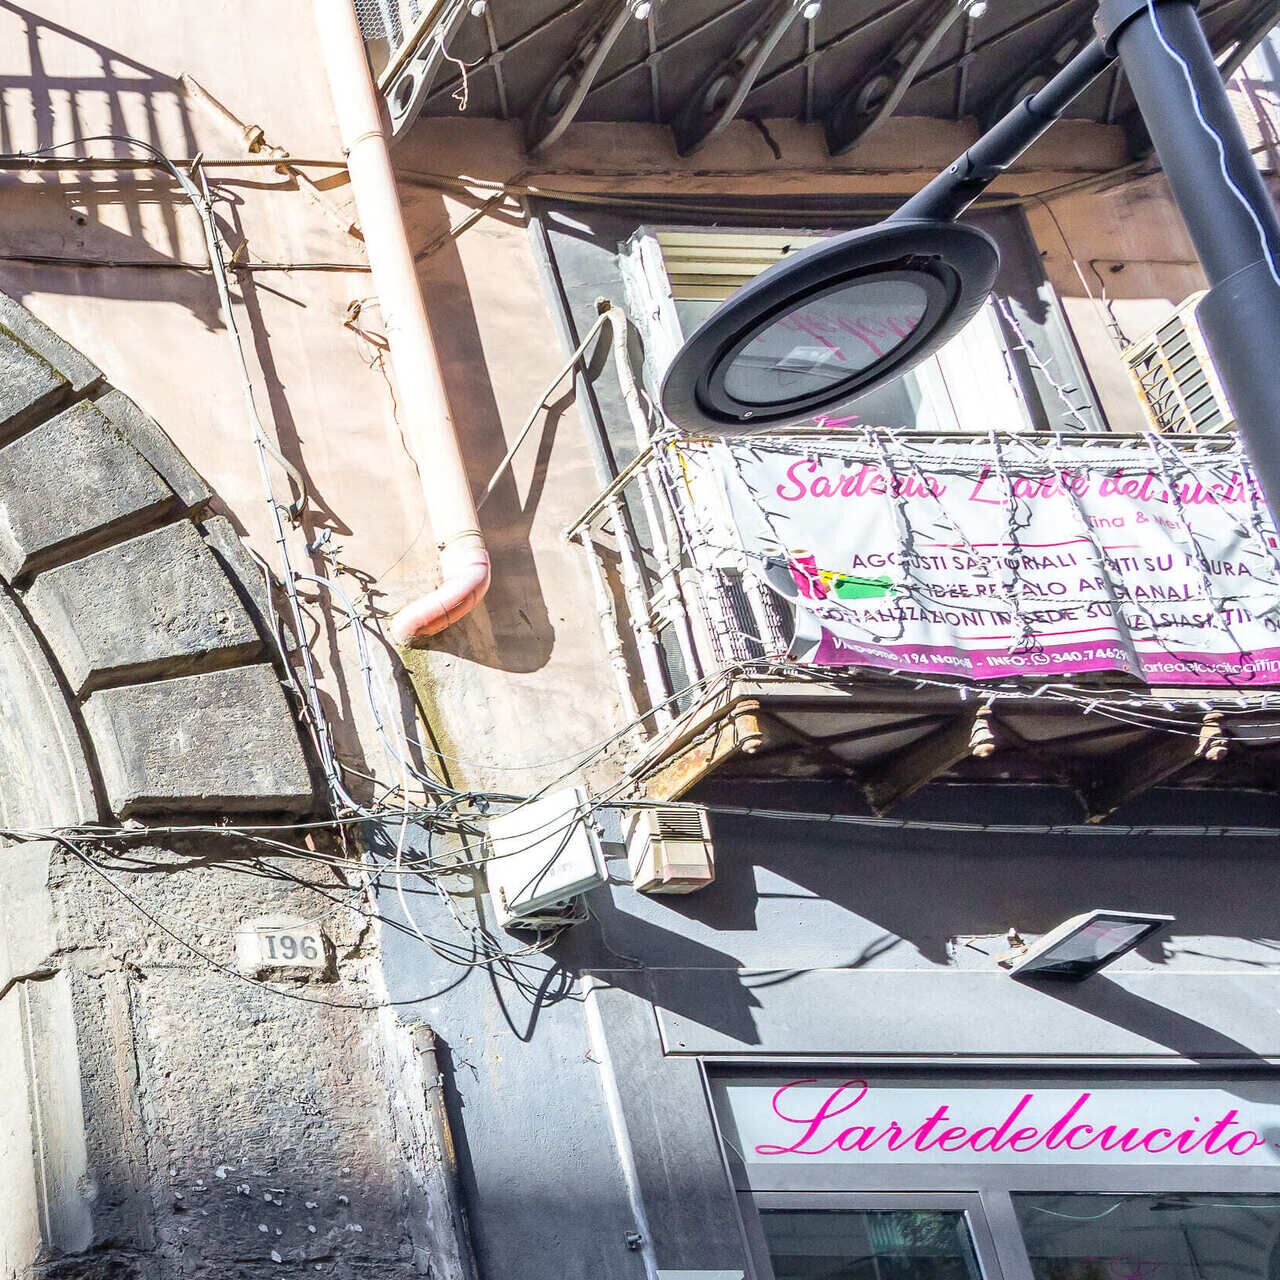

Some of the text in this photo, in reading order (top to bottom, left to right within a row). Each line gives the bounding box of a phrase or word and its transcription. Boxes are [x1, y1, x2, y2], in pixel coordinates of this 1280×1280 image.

[975, 581, 1068, 598] REALO
[265, 935, 318, 960] 196
[755, 1079, 1266, 1156] Lartedelcucito
